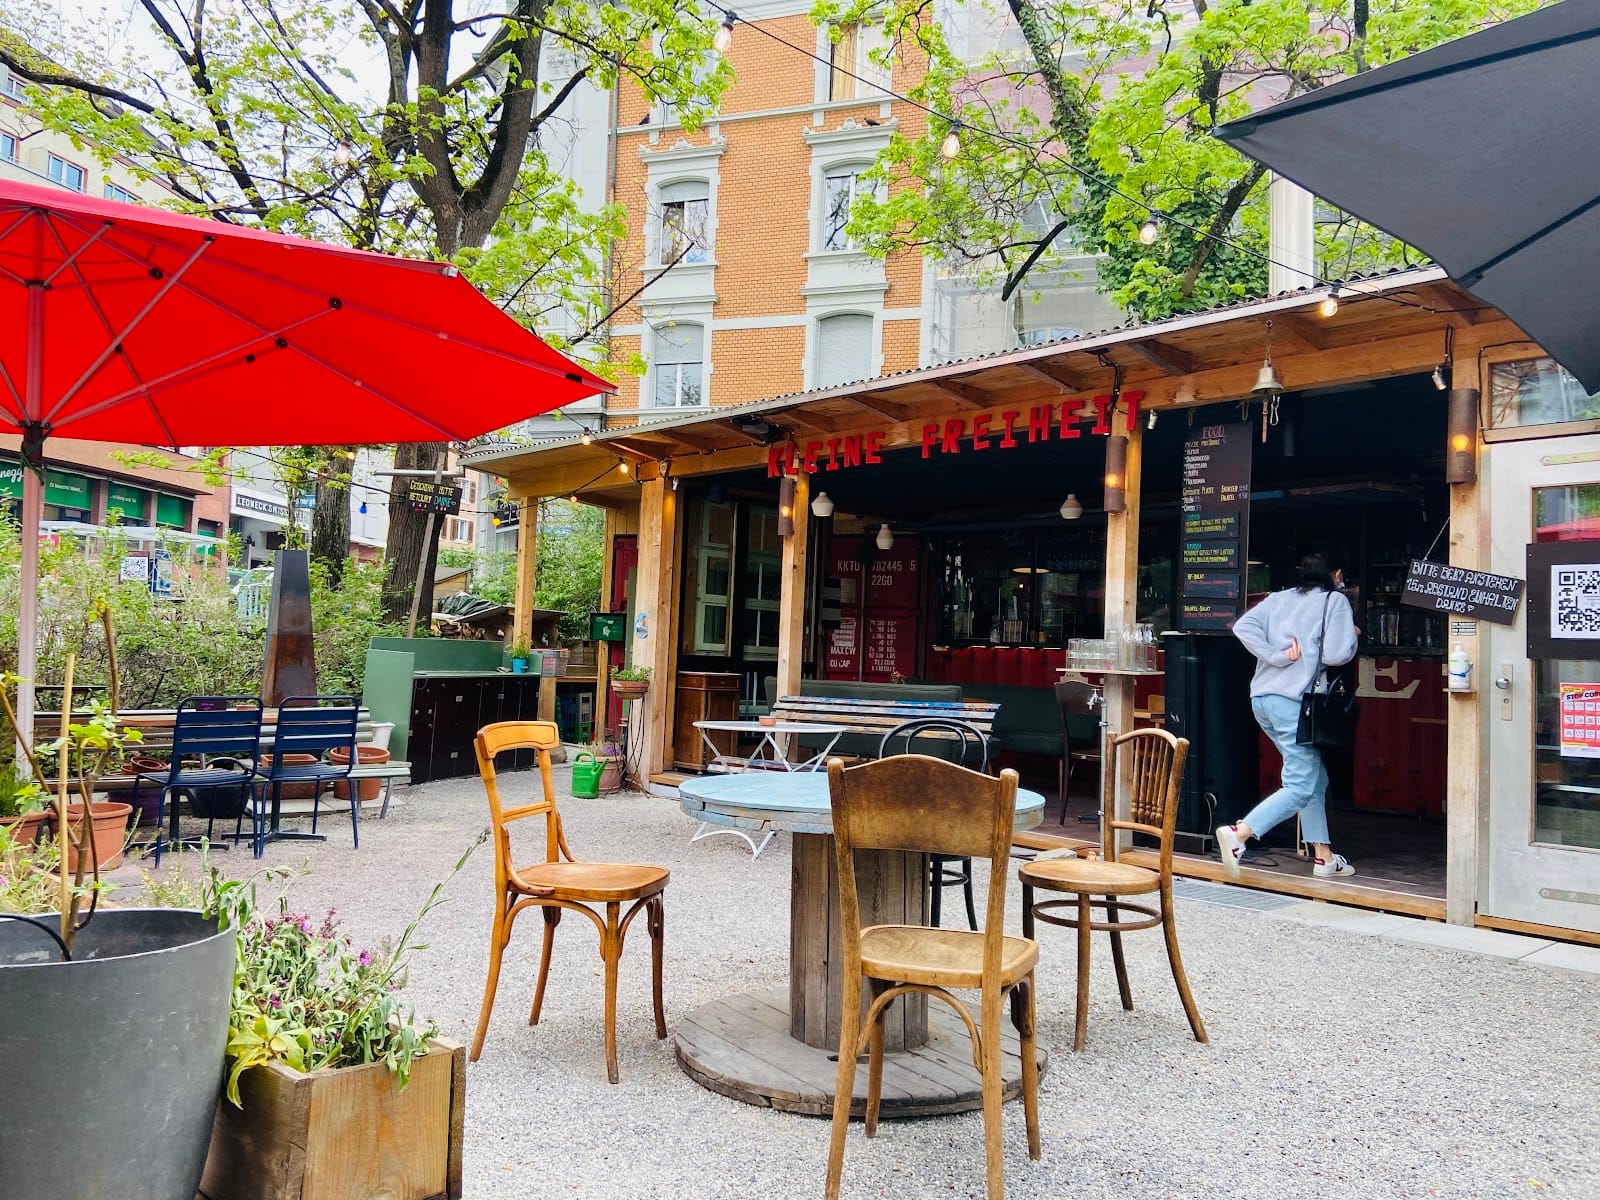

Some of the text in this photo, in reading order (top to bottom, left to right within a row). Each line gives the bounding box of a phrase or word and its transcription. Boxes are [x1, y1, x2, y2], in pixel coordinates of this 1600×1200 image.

[767, 391, 1144, 478] KLEINE FREIHEIT
[910, 560, 916, 571] 5
[1412, 561, 1519, 592] BITTE BEIM ANSTEHEN
[1424, 581, 1469, 600] ABSTAND
[1468, 589, 1520, 611] EINHALTEN
[1435, 598, 1466, 613] DANKE
